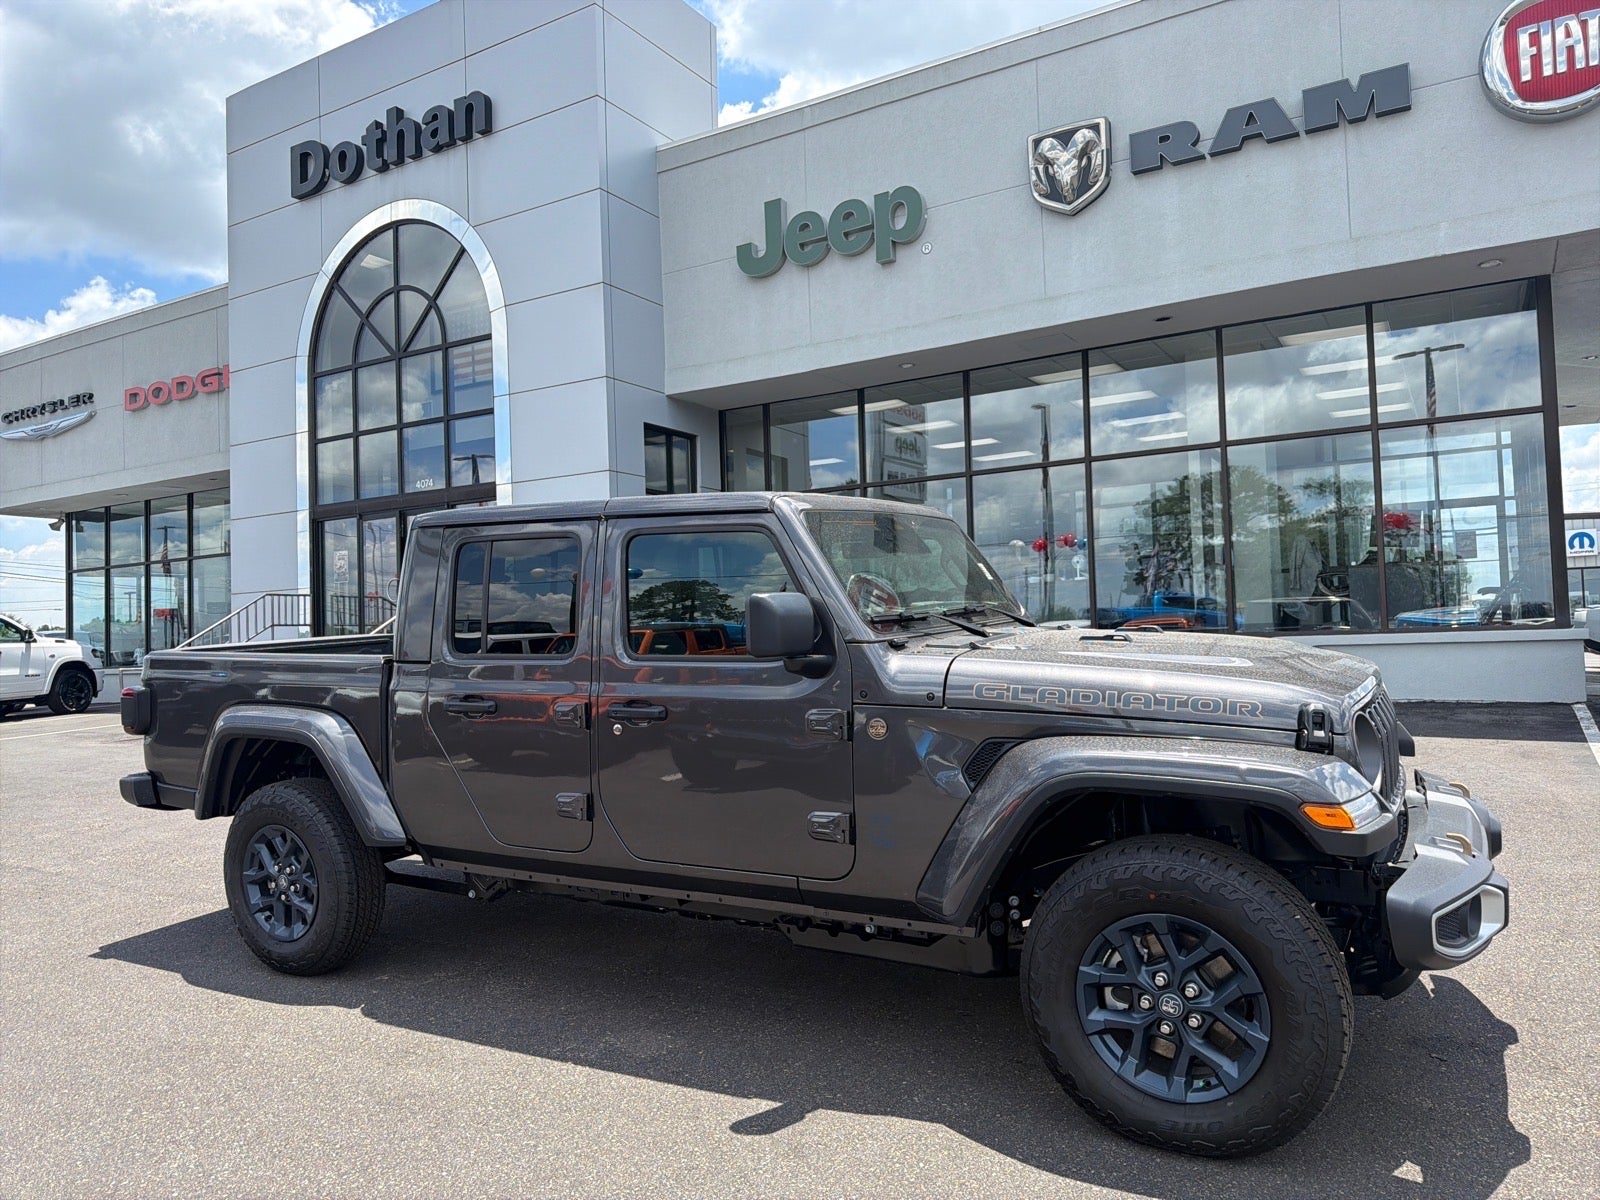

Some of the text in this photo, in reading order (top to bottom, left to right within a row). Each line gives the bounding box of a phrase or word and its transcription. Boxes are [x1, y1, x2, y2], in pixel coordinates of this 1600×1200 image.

[1517, 9, 1600, 83] FIAT
[290, 90, 493, 200] Dothan
[1129, 62, 1412, 176] RAM
[736, 184, 928, 278] Jeep
[1, 391, 95, 425] CHRYSLER
[415, 478, 434, 489] 4074
[973, 682, 1264, 719] GLADIATOR
